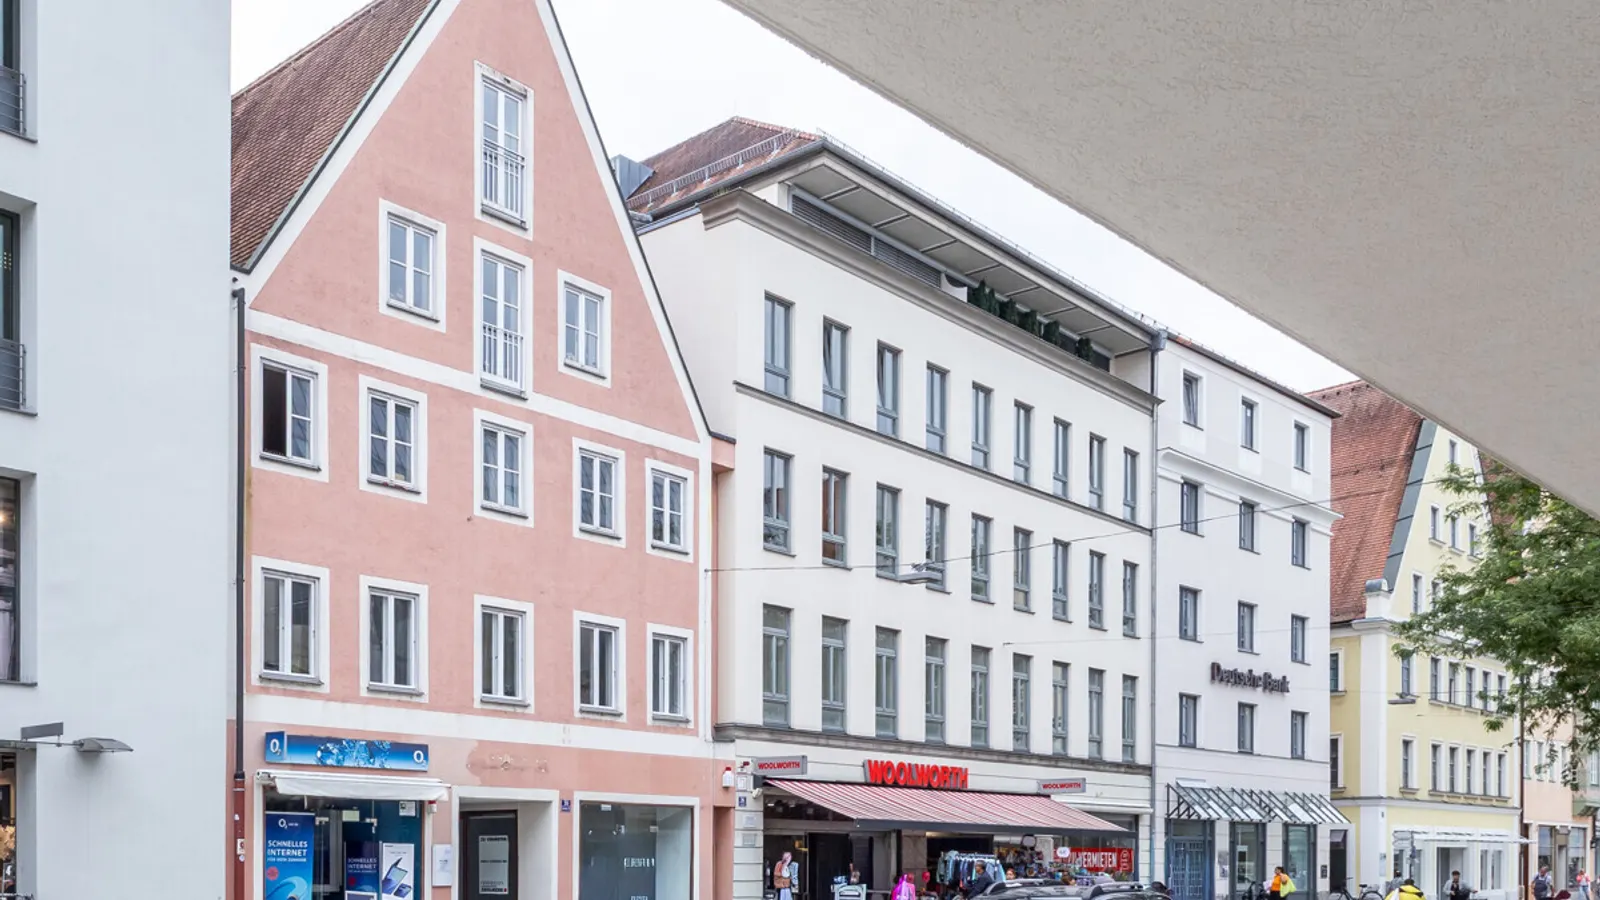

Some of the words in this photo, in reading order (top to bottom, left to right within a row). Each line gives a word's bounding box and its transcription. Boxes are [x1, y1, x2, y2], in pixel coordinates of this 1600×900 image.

[1210, 661, 1262, 688] Deutsche
[1262, 672, 1290, 693] Bank
[757, 761, 800, 770] WOOLWORTH
[864, 759, 969, 789] WOOLWORTH
[267, 840, 308, 848] SCHNELLES
[267, 849, 307, 857] INTERNET
